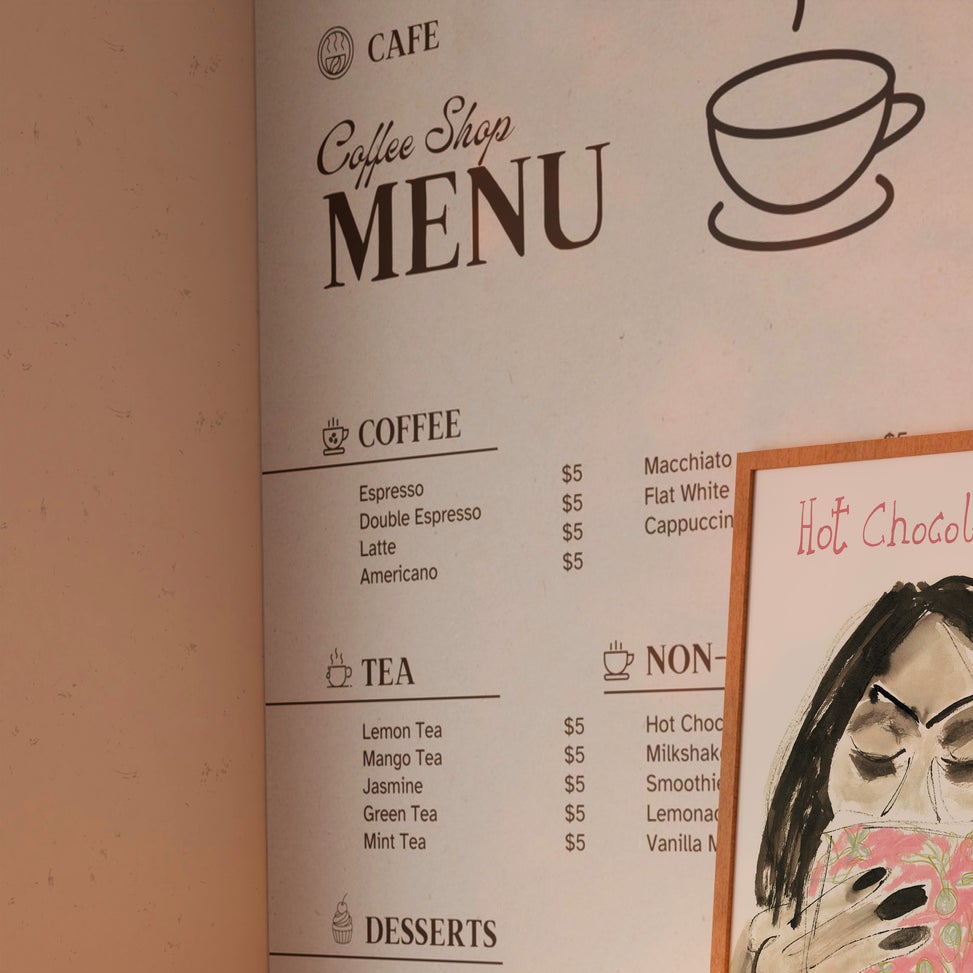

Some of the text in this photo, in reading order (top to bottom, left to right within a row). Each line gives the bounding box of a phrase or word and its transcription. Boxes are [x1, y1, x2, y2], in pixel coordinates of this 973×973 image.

[368, 20, 439, 63] CAFE
[316, 95, 515, 190] Coffee Shop
[322, 142, 611, 290] MENU
[358, 409, 462, 448] COFFEE
[645, 451, 732, 475] Macchiato
[562, 464, 582, 484] $5
[359, 481, 424, 504] Espresso
[645, 480, 730, 506] Flat White
[562, 493, 583, 514] $5
[359, 507, 481, 530] Double Espresso
[797, 496, 850, 556] Hot
[562, 522, 583, 543] $5
[359, 539, 397, 557] Latte
[563, 552, 583, 572] $5
[360, 564, 438, 585] Americano
[359, 656, 415, 687] TEA
[362, 721, 442, 740] Lemon Tea
[564, 716, 584, 736] $5
[646, 715, 675, 733] Hot
[362, 749, 442, 771] Mango Tea
[564, 745, 585, 765] $5
[647, 743, 721, 762] Milkshak
[362, 777, 423, 795] Jasmine
[565, 774, 585, 794] $5
[362, 805, 438, 823] Green Tea
[565, 803, 585, 824] $5
[364, 832, 426, 850] Mint Tea
[565, 832, 585, 852] $5
[646, 833, 702, 852] Vanilla
[365, 916, 497, 948] DESSERTS
